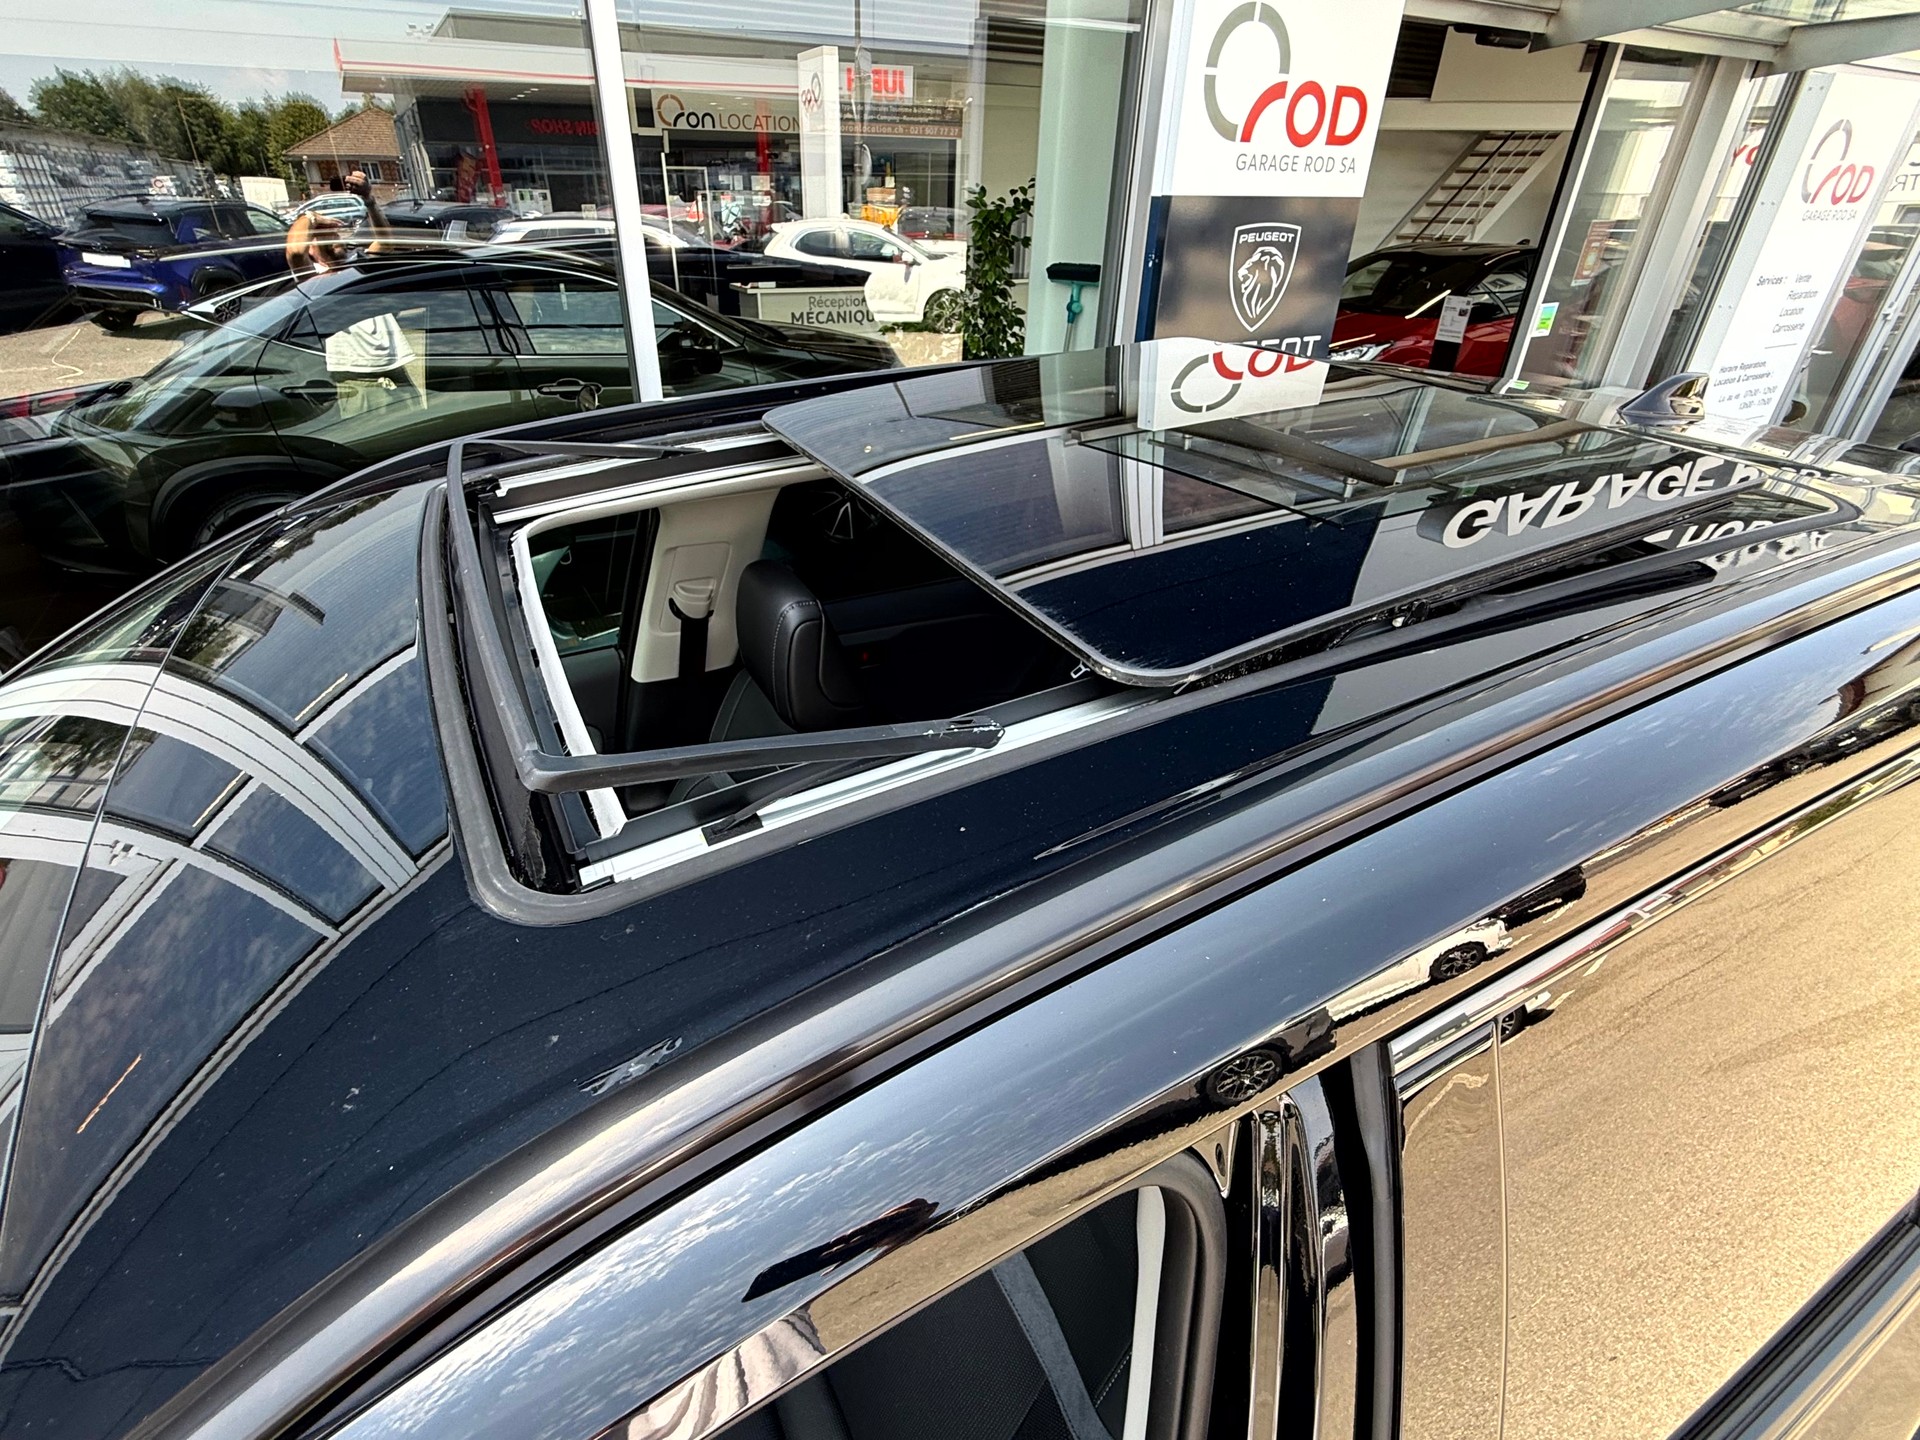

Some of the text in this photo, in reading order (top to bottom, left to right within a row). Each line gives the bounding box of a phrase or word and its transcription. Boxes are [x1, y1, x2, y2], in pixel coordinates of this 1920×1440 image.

[718, 112, 801, 132] LOCATION
[1235, 153, 1357, 174] GARAGE ROD SA
[1238, 231, 1296, 244] PEUGEOT
[807, 295, 868, 310] Réception
[790, 306, 875, 326] MÉCANIQU
[1779, 307, 1805, 318] Location
